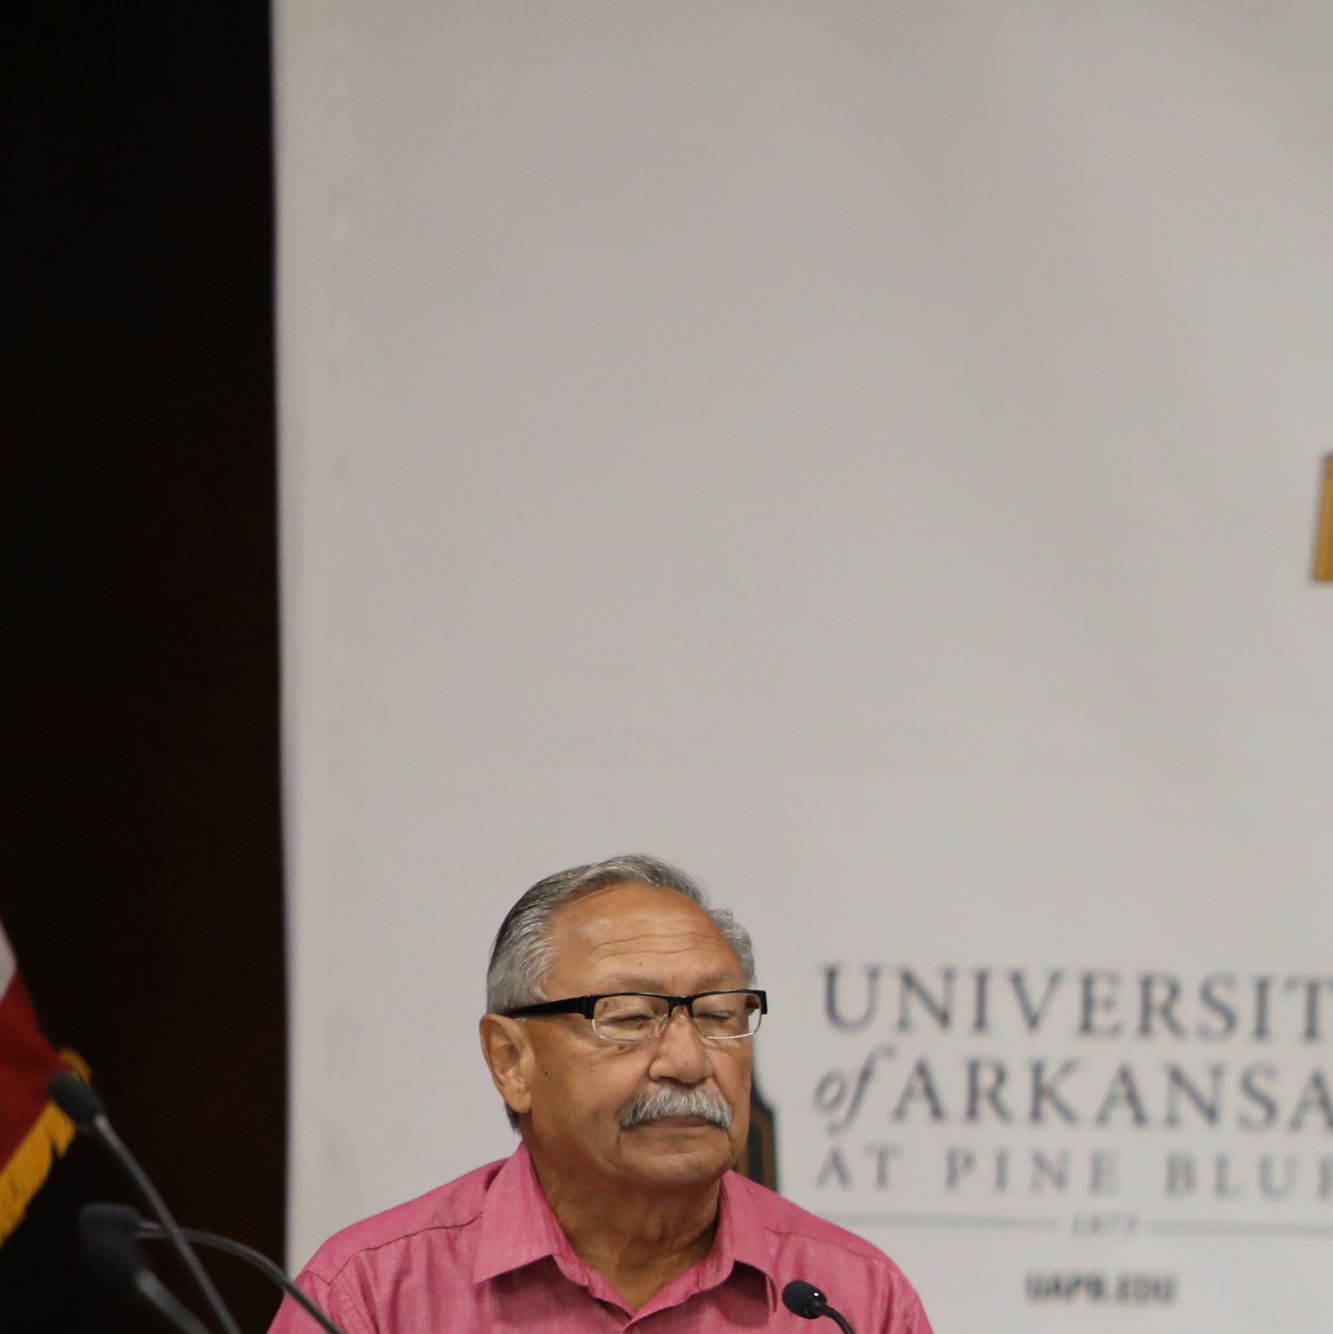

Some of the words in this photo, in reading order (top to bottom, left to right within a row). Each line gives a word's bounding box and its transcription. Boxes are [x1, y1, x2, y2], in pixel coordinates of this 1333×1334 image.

[813, 1045, 897, 1137] of
[817, 1145, 902, 1191] AT
[944, 1147, 1120, 1196] PINE
